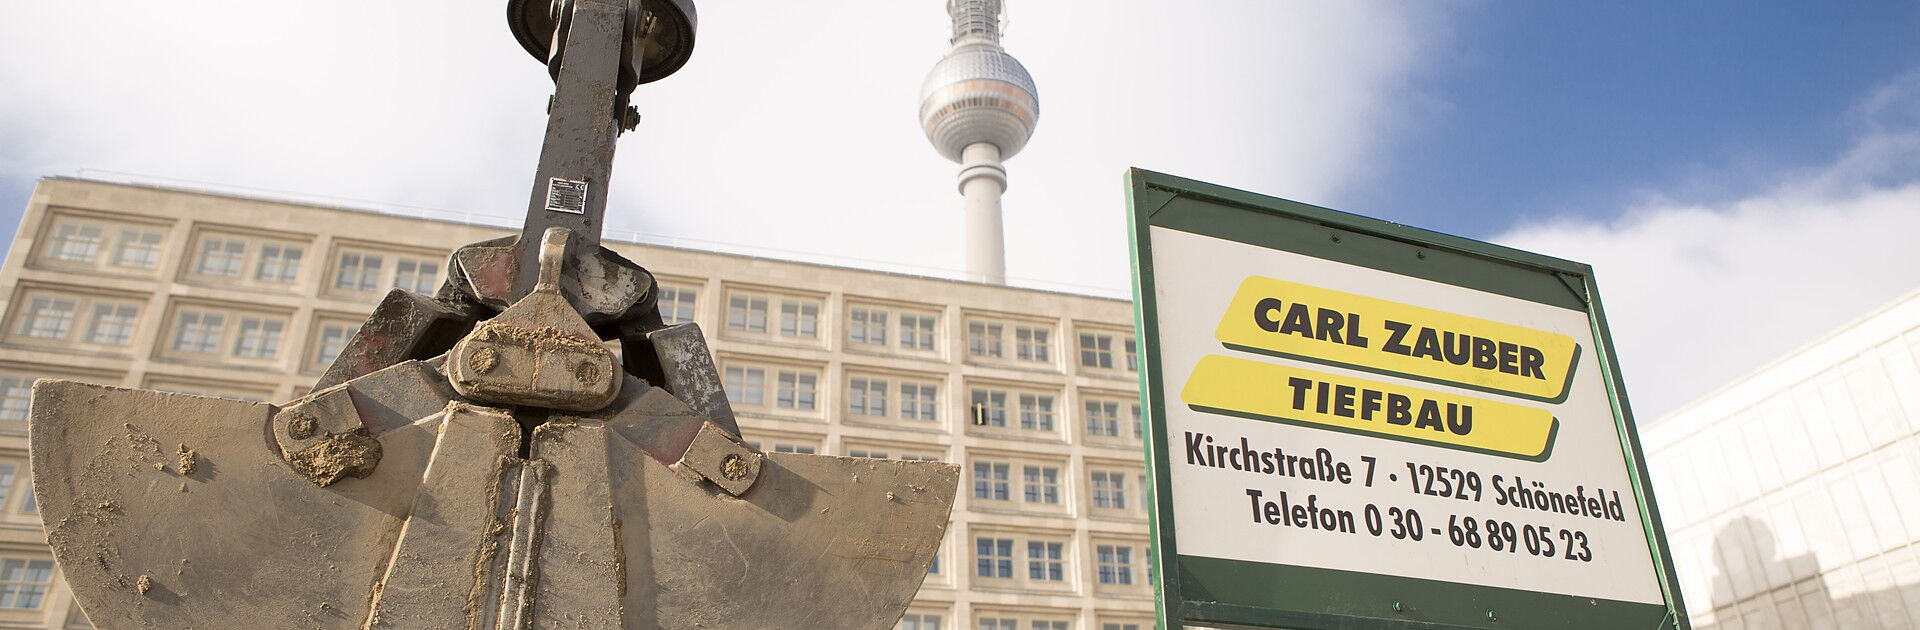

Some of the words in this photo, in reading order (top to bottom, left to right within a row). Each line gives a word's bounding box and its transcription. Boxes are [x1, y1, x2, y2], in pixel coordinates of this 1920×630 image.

[1254, 297, 1369, 349] CARL
[1381, 319, 1546, 381] ZAUBER
[1288, 376, 1473, 436] TIEFBAU
[1184, 431, 1352, 485] Kirchstraße
[1360, 455, 1377, 488] 7
[1406, 462, 1482, 502] 12529
[1492, 474, 1626, 522] Schönefeld
[1245, 488, 1356, 534] Telefon
